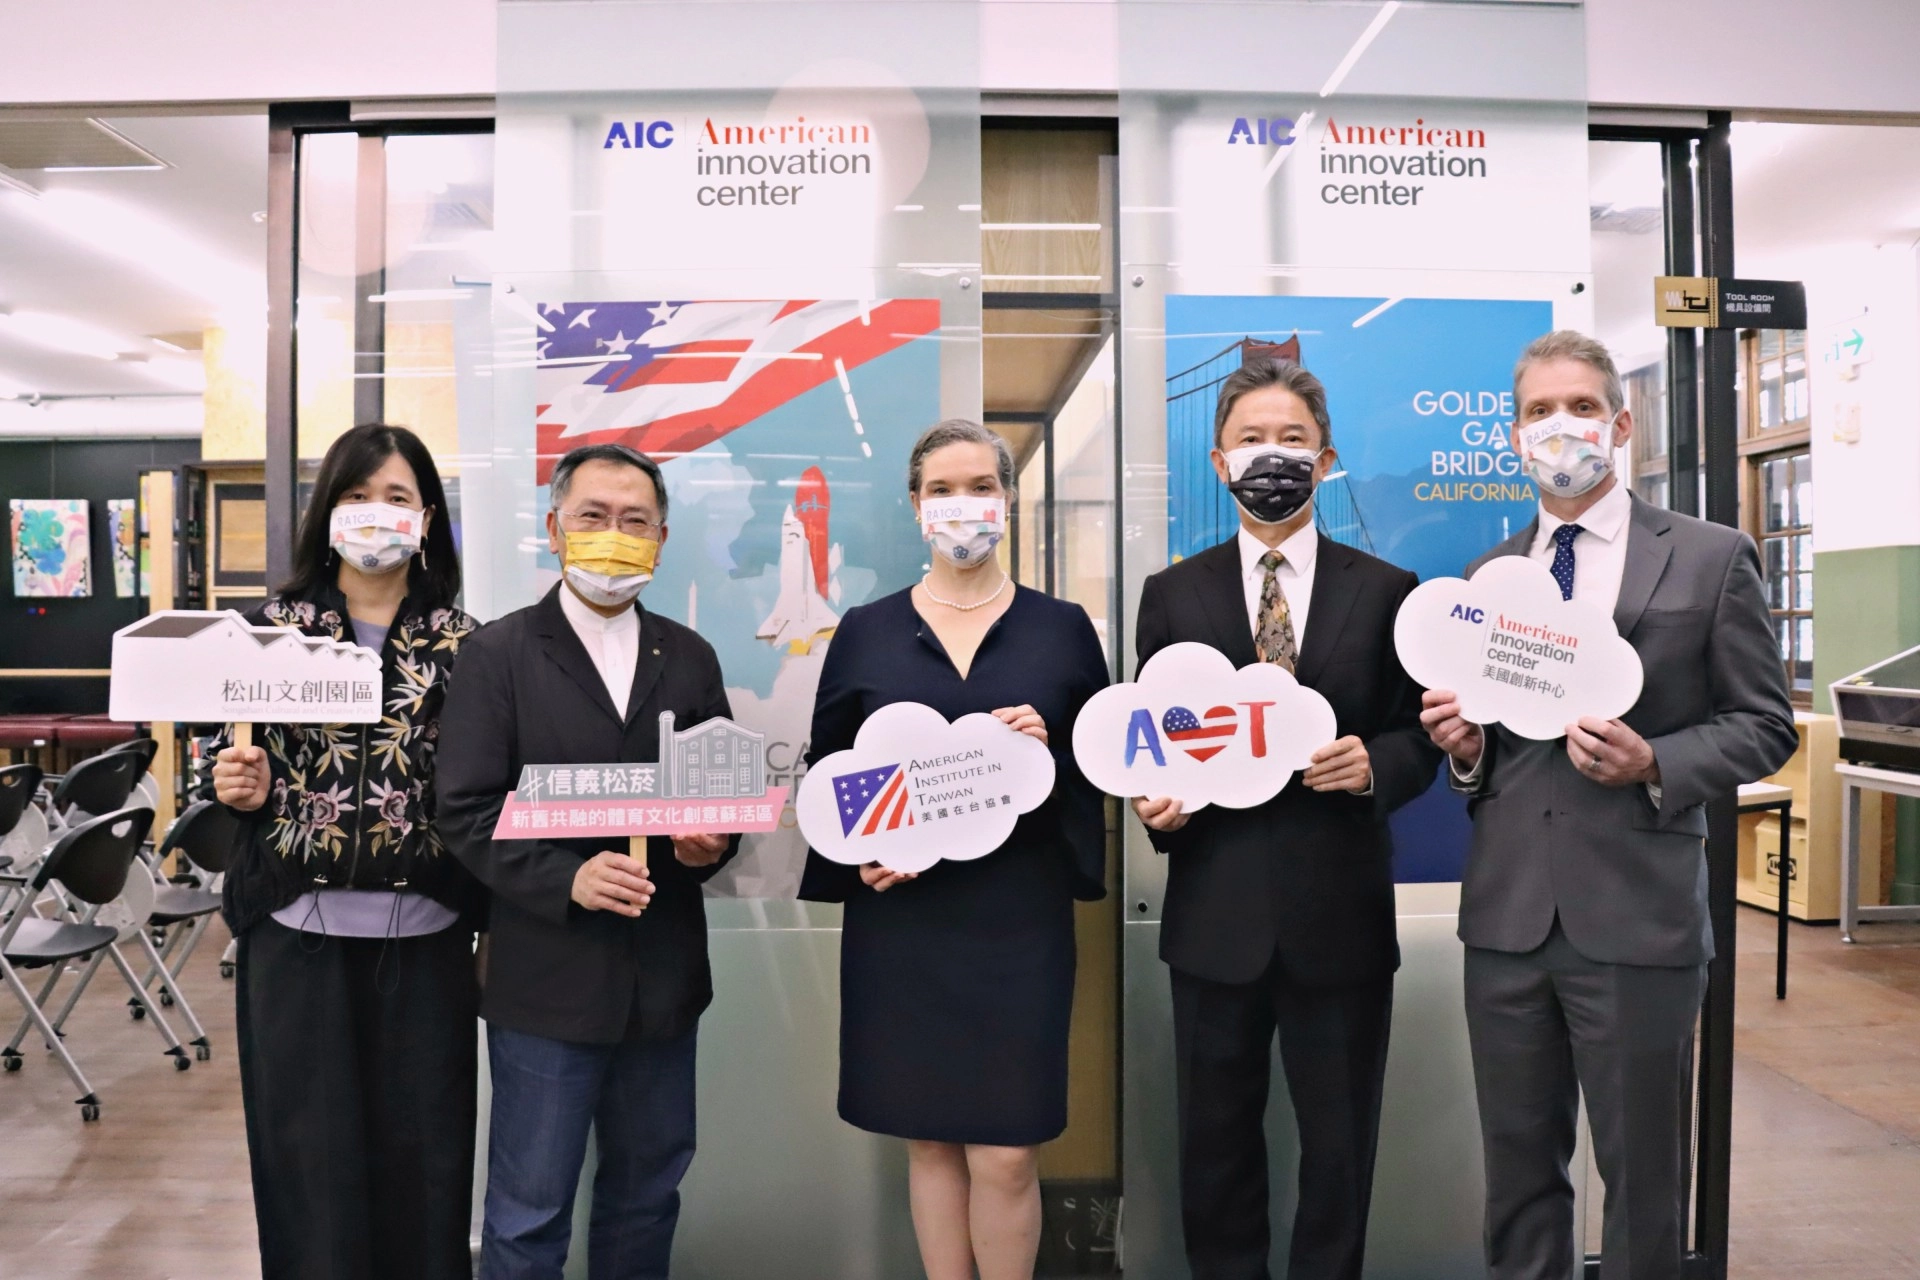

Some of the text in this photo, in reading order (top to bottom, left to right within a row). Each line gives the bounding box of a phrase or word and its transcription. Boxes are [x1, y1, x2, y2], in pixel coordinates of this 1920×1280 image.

[603, 116, 870, 149] AIC American
[1228, 117, 1487, 148] AIC American
[697, 148, 871, 175] innovation
[1320, 147, 1487, 177] innovation
[696, 180, 804, 206] center
[1320, 180, 1424, 206] center
[1725, 292, 1775, 302] TOOL ROOM
[1413, 390, 1513, 417] GOLDE
[1432, 451, 1529, 476] BRIDG
[1414, 482, 1535, 502] CALIFORNIA
[1450, 603, 1579, 649] AIC American
[1490, 628, 1575, 664] innovation
[1487, 648, 1539, 671] center
[221, 679, 375, 703] 松山文創園區
[1482, 664, 1565, 699] 美國創新中心
[302, 705, 318, 715] and
[908, 748, 984, 773] AMERICAN
[915, 762, 1002, 789] INSTITUTE IN
[915, 787, 974, 807] TAIWAN
[921, 794, 1011, 823] 美國在台協會
[511, 804, 774, 829] 新舊共融的體育文化創意蘇活區
